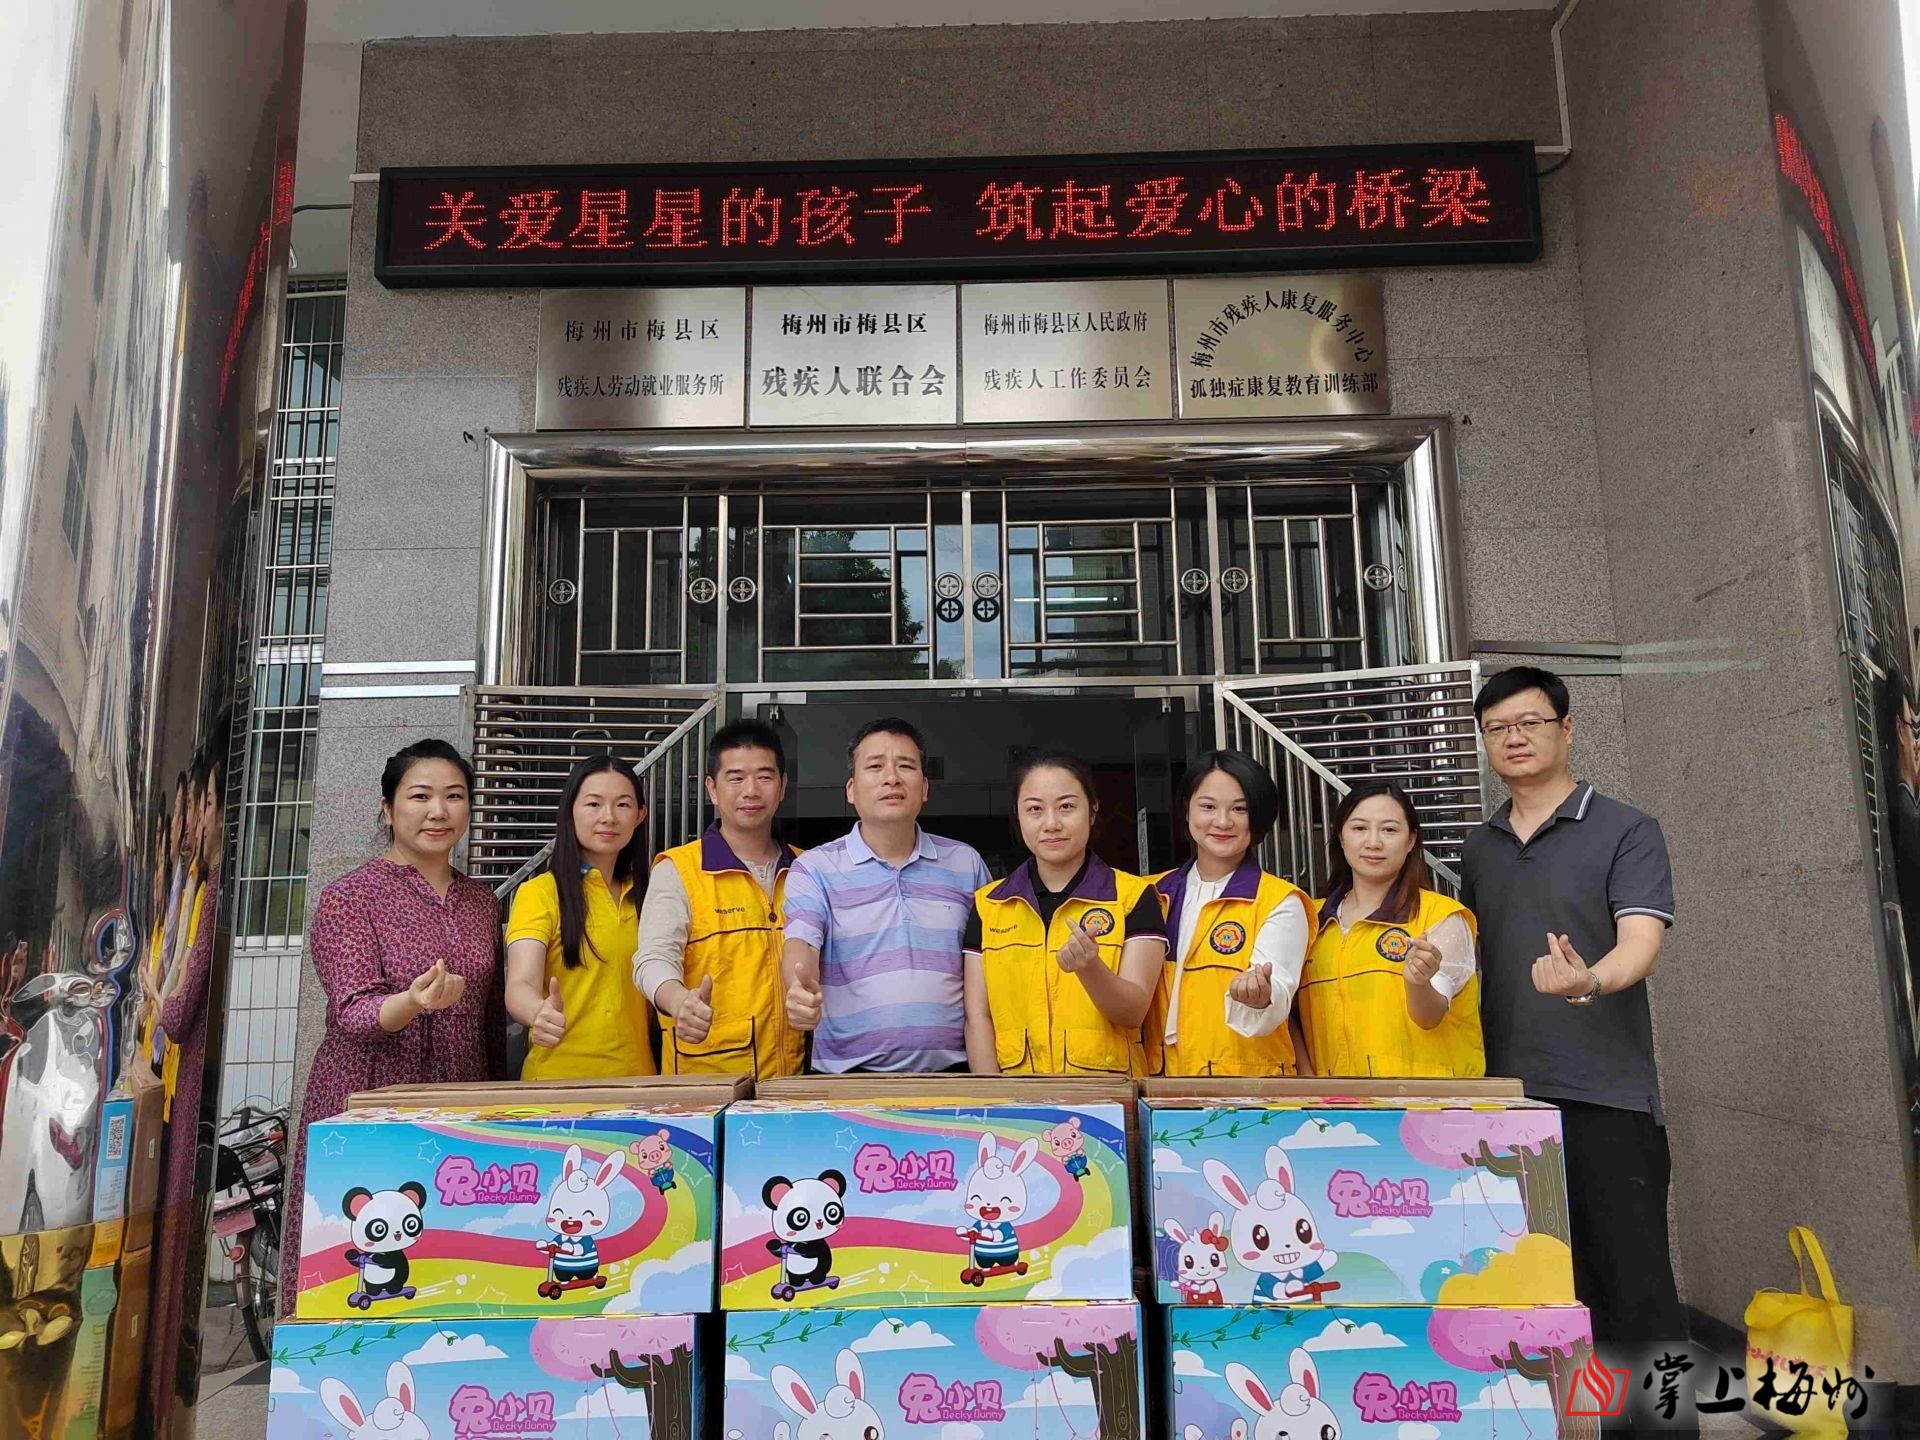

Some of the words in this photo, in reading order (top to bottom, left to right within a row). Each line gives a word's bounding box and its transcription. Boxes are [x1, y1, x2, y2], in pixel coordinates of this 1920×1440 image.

[423, 184, 932, 250] 关爱星星的孩子
[975, 167, 1491, 241] 筑起爱心的桥梁
[564, 318, 721, 342] 梅州市梅县区
[780, 312, 929, 336] 梅州市梅县区
[983, 309, 1148, 337] 梅州市梅县区人民政府
[1189, 288, 1375, 370] 梅州市残疾人康复服务中心
[556, 373, 726, 399] 残疾人劳动就业服务所
[761, 363, 947, 398] 残疾人联合会
[983, 363, 1152, 391] 残疾人工作委员会
[1190, 372, 1379, 399] 孤独症康复教育训练部
[435, 1155, 538, 1206] 兔小贝
[853, 1143, 955, 1193] 兔小贝
[1328, 1169, 1429, 1217] 兔小贝
[449, 1384, 554, 1434] 兔小贝
[898, 1372, 1002, 1423] 兔小贝
[1353, 1372, 1457, 1423] 兔小贝
